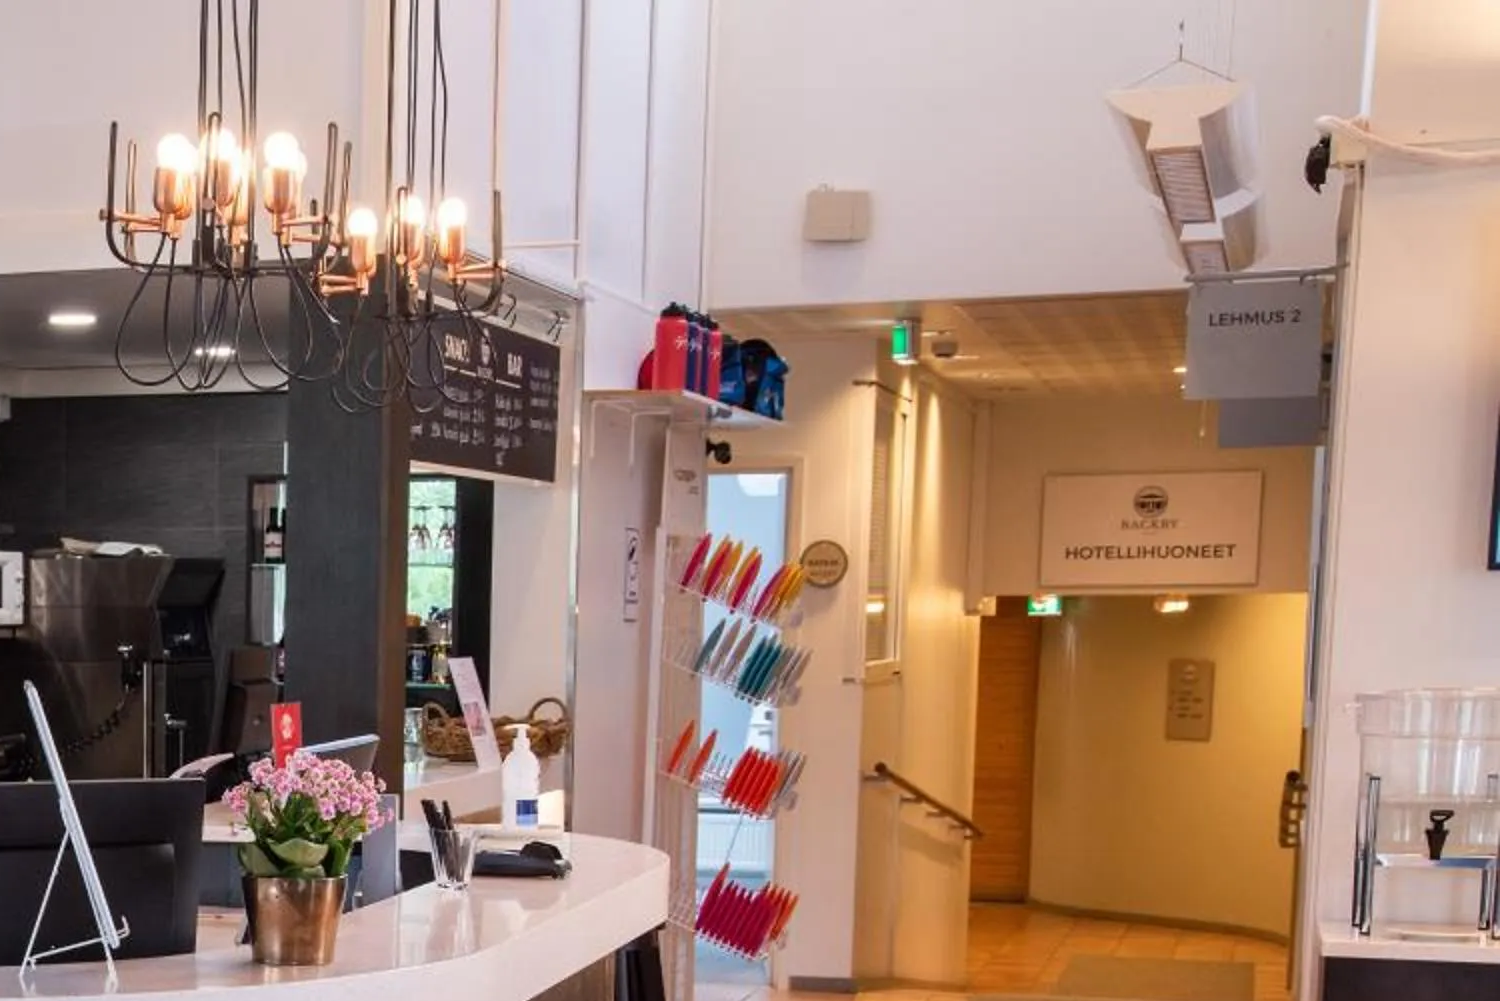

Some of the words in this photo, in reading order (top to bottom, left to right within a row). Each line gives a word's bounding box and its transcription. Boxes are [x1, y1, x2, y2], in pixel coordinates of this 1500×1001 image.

[1208, 310, 1285, 327] LEHMUS
[1291, 309, 1301, 323] 2
[1064, 544, 1237, 561] HOTELLIHUONEET
